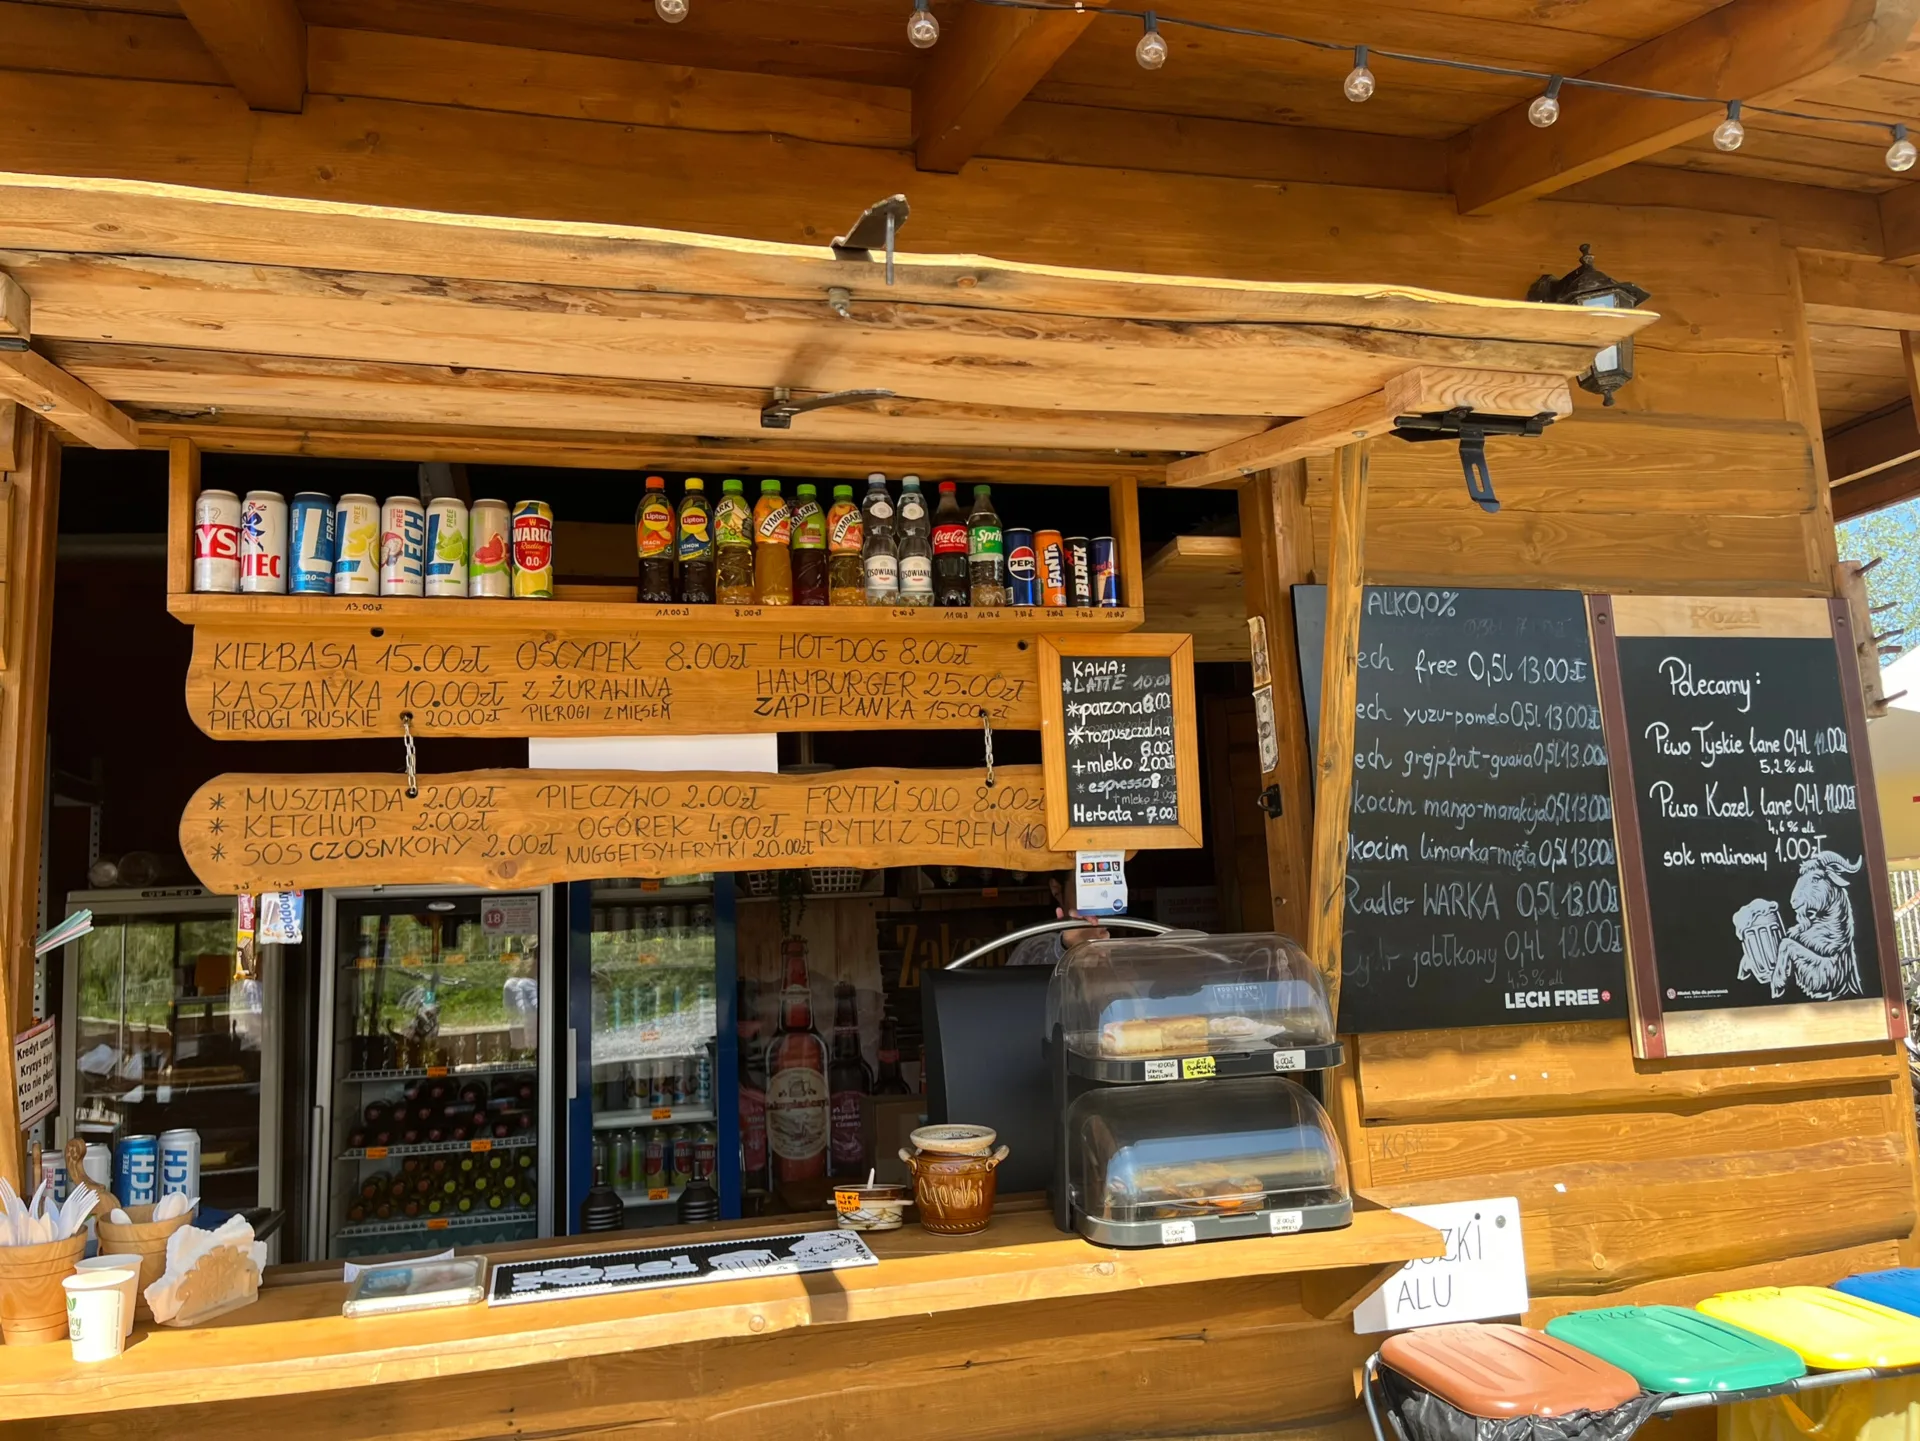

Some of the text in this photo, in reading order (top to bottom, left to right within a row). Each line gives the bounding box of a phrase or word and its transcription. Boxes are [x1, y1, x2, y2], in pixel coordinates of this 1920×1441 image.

[326, 509, 334, 541] FREE
[646, 513, 667, 521] Lipton
[404, 510, 423, 577] LECH
[512, 527, 552, 544] WARKA
[1044, 544, 1062, 588] FANTA
[1073, 544, 1089, 597] BLACK
[213, 642, 490, 673] KIEŁBASA 15.00zł
[665, 641, 757, 671] 8.00zł
[779, 634, 978, 665] HOT-DOG 8.00zł
[1415, 649, 1458, 683] free
[211, 680, 508, 710] KASZANKA 10.00zł
[551, 674, 673, 704] ŻURAWINĄ
[755, 669, 1035, 701] HAMBURGER 25.00zł
[208, 707, 510, 730] PIEROGI RUSKIE 20.00zł
[521, 704, 590, 721] PIEROGI
[754, 694, 919, 720] ZAPIEKANKA
[1404, 703, 1509, 727] yuzu-pomelo
[1645, 721, 1692, 756] Piwo
[1691, 721, 1744, 768] Tyskie
[245, 786, 506, 813] MUSZTARDA 2.00zł
[536, 784, 770, 810] PIECZYWO 2.00zł
[806, 783, 898, 814] FRYTKI
[907, 786, 960, 812] SOLO
[1650, 780, 1698, 818] Piwo
[1705, 781, 1754, 818] Kozel
[243, 810, 499, 838] KETCHUP 2.00zł
[577, 813, 790, 841] OGÓREK 4.00zł
[1073, 803, 1133, 823] Herbata
[241, 832, 562, 866] SOS CZOSNKOWY 2.00zł
[803, 820, 893, 847] FRYTKI
[924, 820, 1010, 849] SEREM
[1664, 842, 1695, 867] sok
[1701, 844, 1768, 871] malinowy
[1345, 875, 1415, 915] Radler
[1424, 880, 1500, 920] WARKA
[487, 912, 501, 924] 18
[1407, 934, 1497, 988] jabłkowy
[1505, 988, 1600, 1009] LECH FREE
[17, 1040, 39, 1061] Kredyt
[19, 1083, 31, 1096] Kto
[21, 1100, 34, 1113] Ten
[122, 1154, 130, 1175] FREE
[1397, 1274, 1452, 1314] ALU
